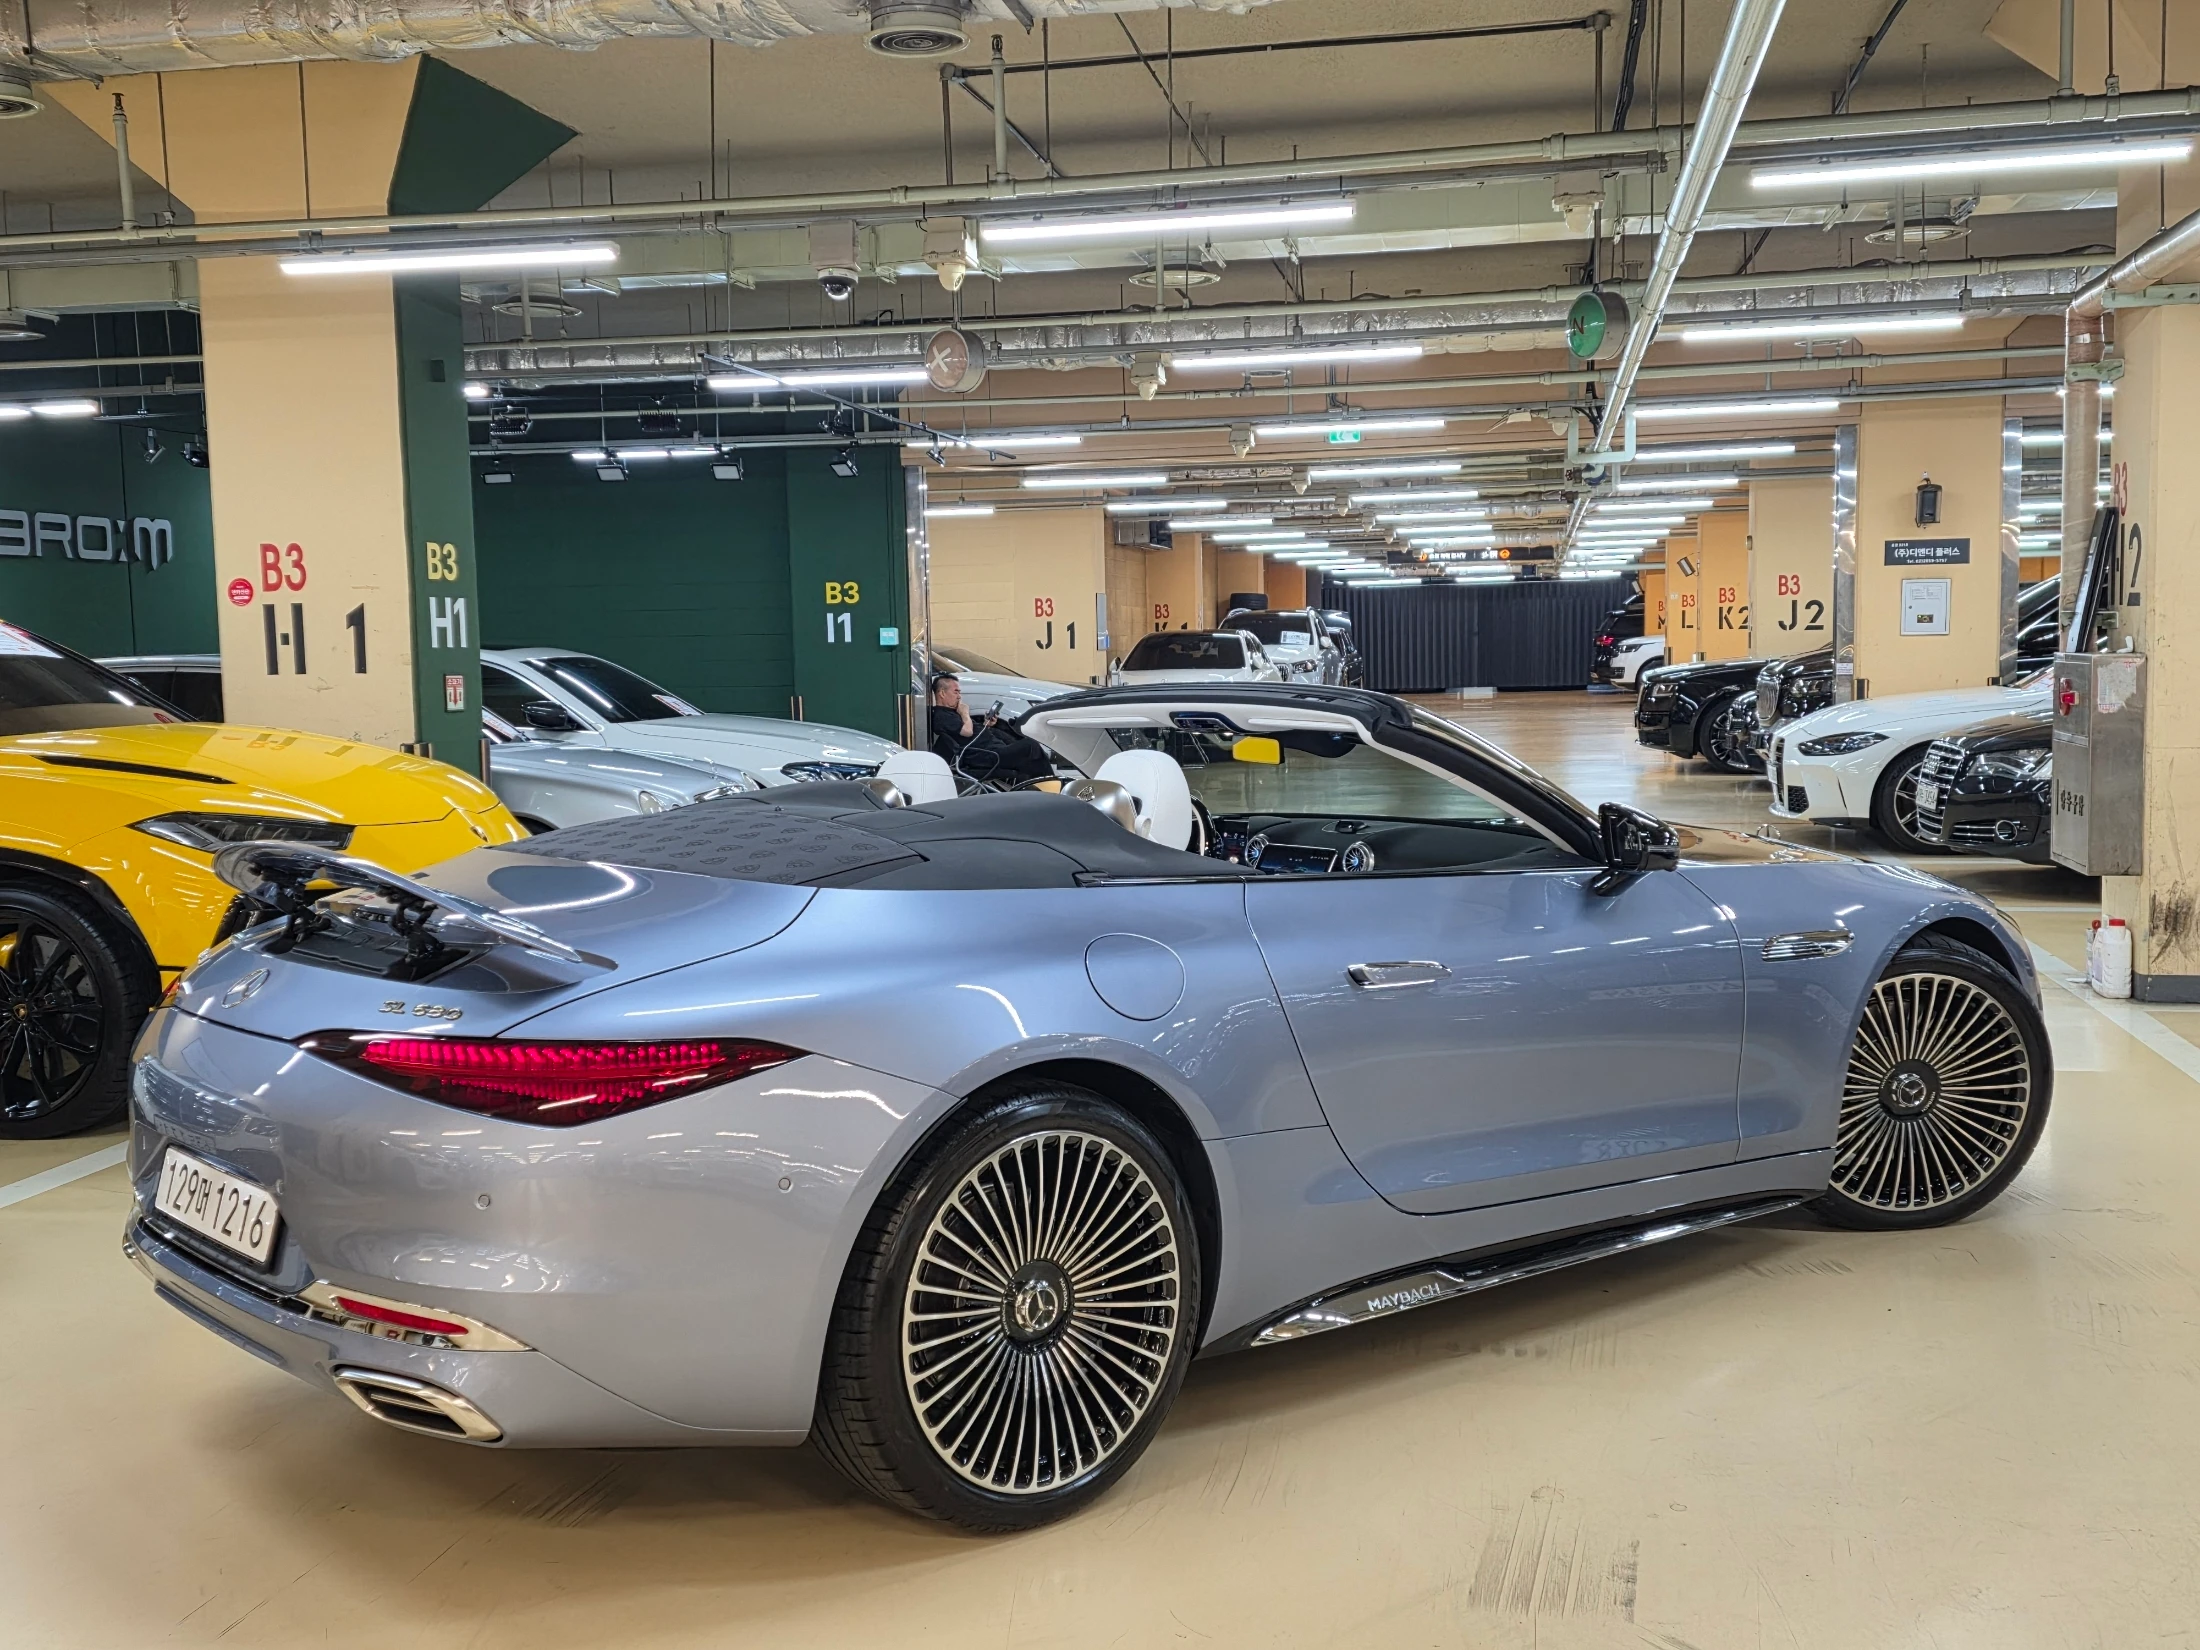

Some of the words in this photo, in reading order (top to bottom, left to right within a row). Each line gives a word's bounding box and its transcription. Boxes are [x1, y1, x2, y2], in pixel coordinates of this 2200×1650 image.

[2114, 461, 2128, 517] B3
[259, 542, 307, 592] B3
[426, 541, 459, 581] B3
[825, 581, 860, 604] B3
[1719, 587, 1736, 604] B3
[1778, 574, 1801, 596] B3
[1034, 597, 1054, 618] B3
[1154, 603, 1170, 620] B3
[1658, 600, 1666, 612] B
[1681, 594, 1696, 608] B3
[429, 596, 468, 648] H1
[1681, 609, 1694, 629] L
[1778, 599, 1825, 631] J2
[378, 1000, 406, 1015] SL
[165, 1160, 213, 1222] 129머
[213, 1183, 267, 1249] 1216
[1367, 1282, 1441, 1312] MAYBACH
